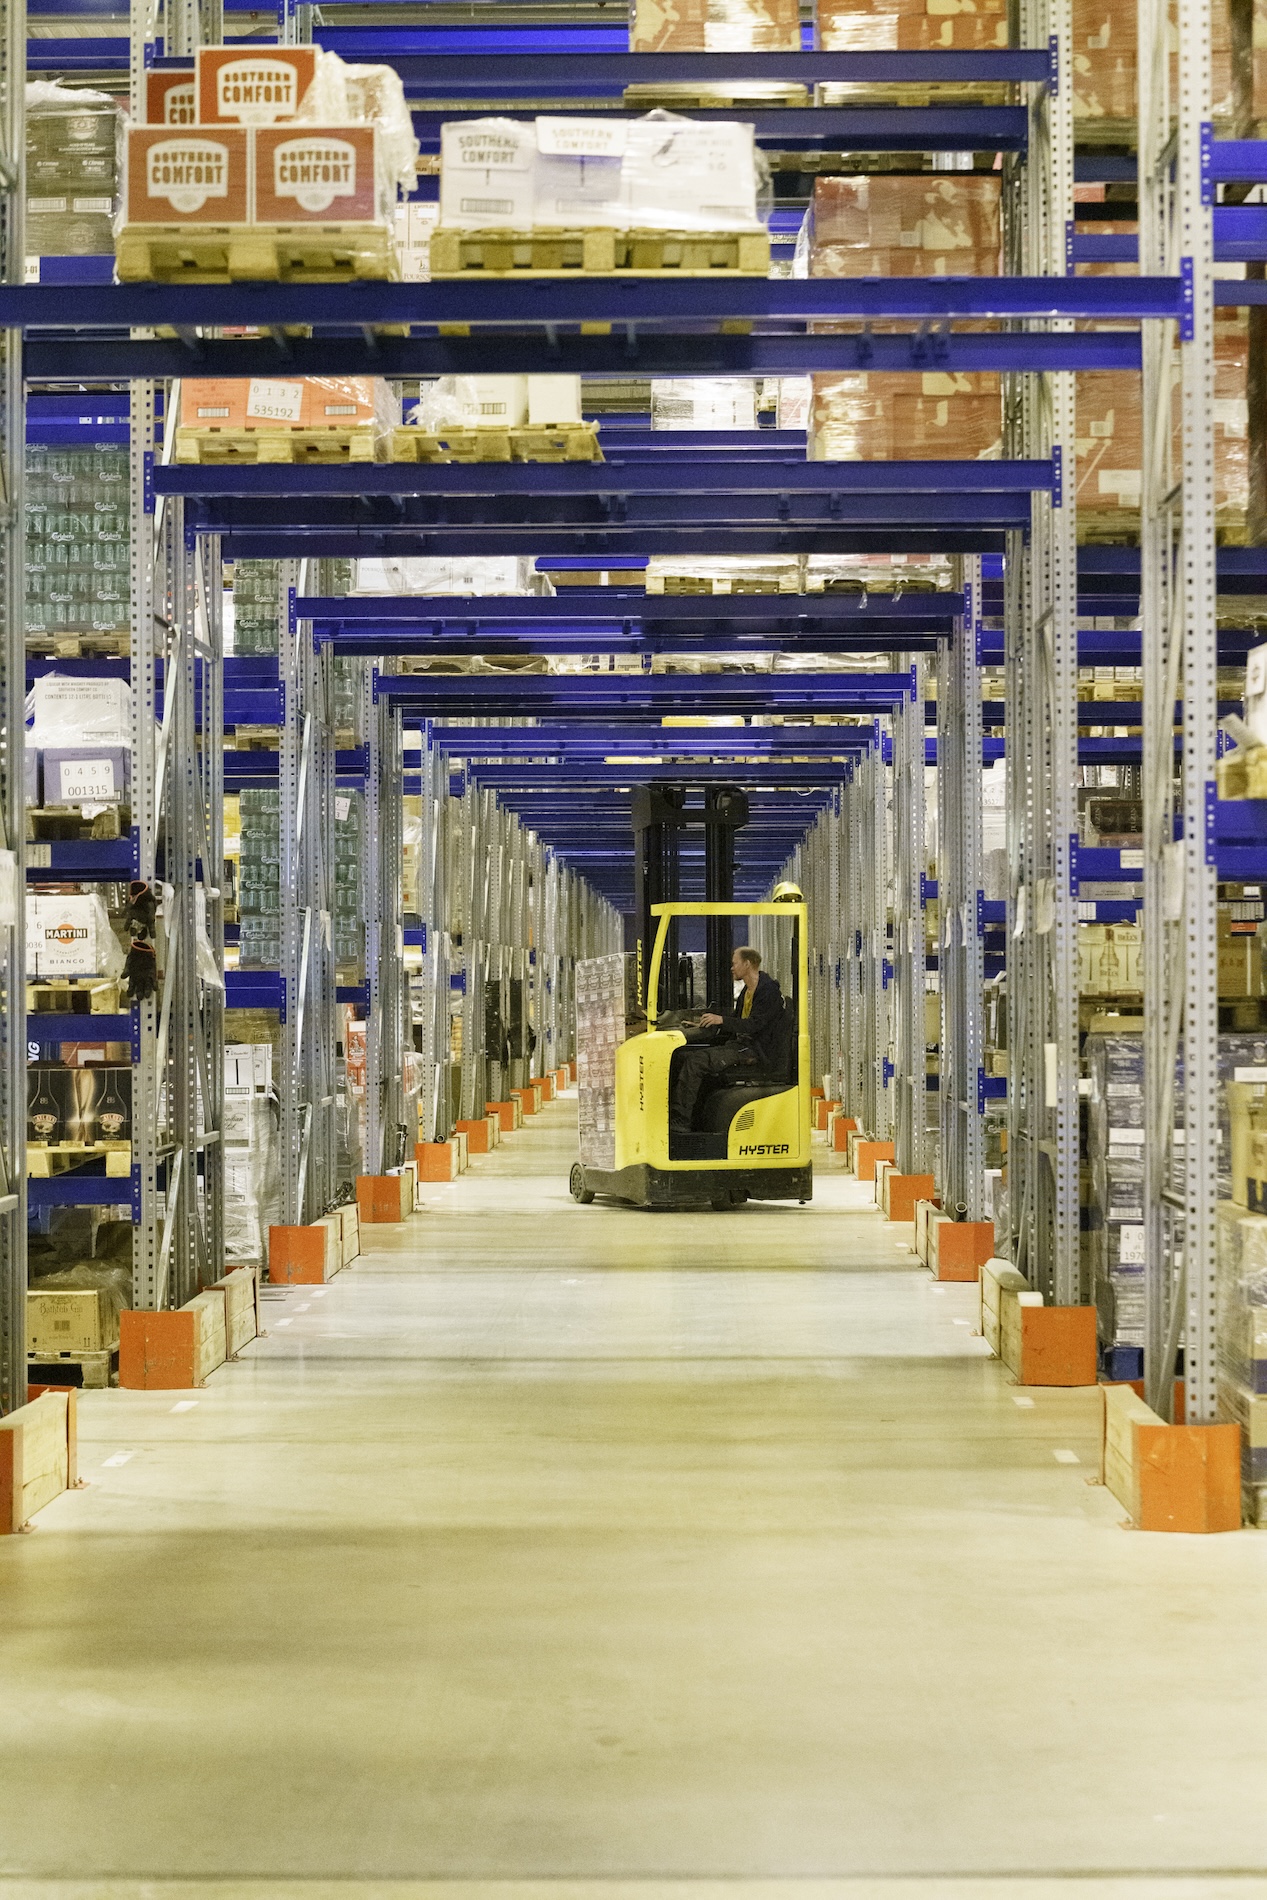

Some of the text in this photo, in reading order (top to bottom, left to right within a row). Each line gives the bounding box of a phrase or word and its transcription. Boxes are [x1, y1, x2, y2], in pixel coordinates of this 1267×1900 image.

[224, 71, 291, 83] SOUTHERN
[222, 85, 292, 104] COMFORT
[555, 138, 609, 150] COMFORT
[153, 151, 223, 163] SOUTHERN
[280, 150, 350, 162] SOUTHERN
[461, 150, 516, 164] COMFORT
[151, 165, 225, 185] COMFORT
[279, 164, 352, 183] COMFORT
[253, 403, 294, 418] 535192
[95, 442, 118, 452] Carlsberg
[52, 472, 75, 483] Carlsberg
[99, 471, 122, 482] Carlsberg
[95, 501, 118, 512] Carlsberg
[51, 531, 75, 542] Carlsberg
[98, 531, 122, 541] Carlsberg
[93, 560, 117, 571] Carlsberg
[50, 592, 74, 602] Carlsberg
[97, 590, 120, 601] Carlsberg
[92, 620, 116, 631] Carlsberg
[45, 693, 68, 701] CONTENTS
[67, 784, 108, 797] 001315
[45, 929, 87, 939] MARTINI
[738, 1144, 790, 1156] HYSTER
[40, 1302, 69, 1315] Bathtub
